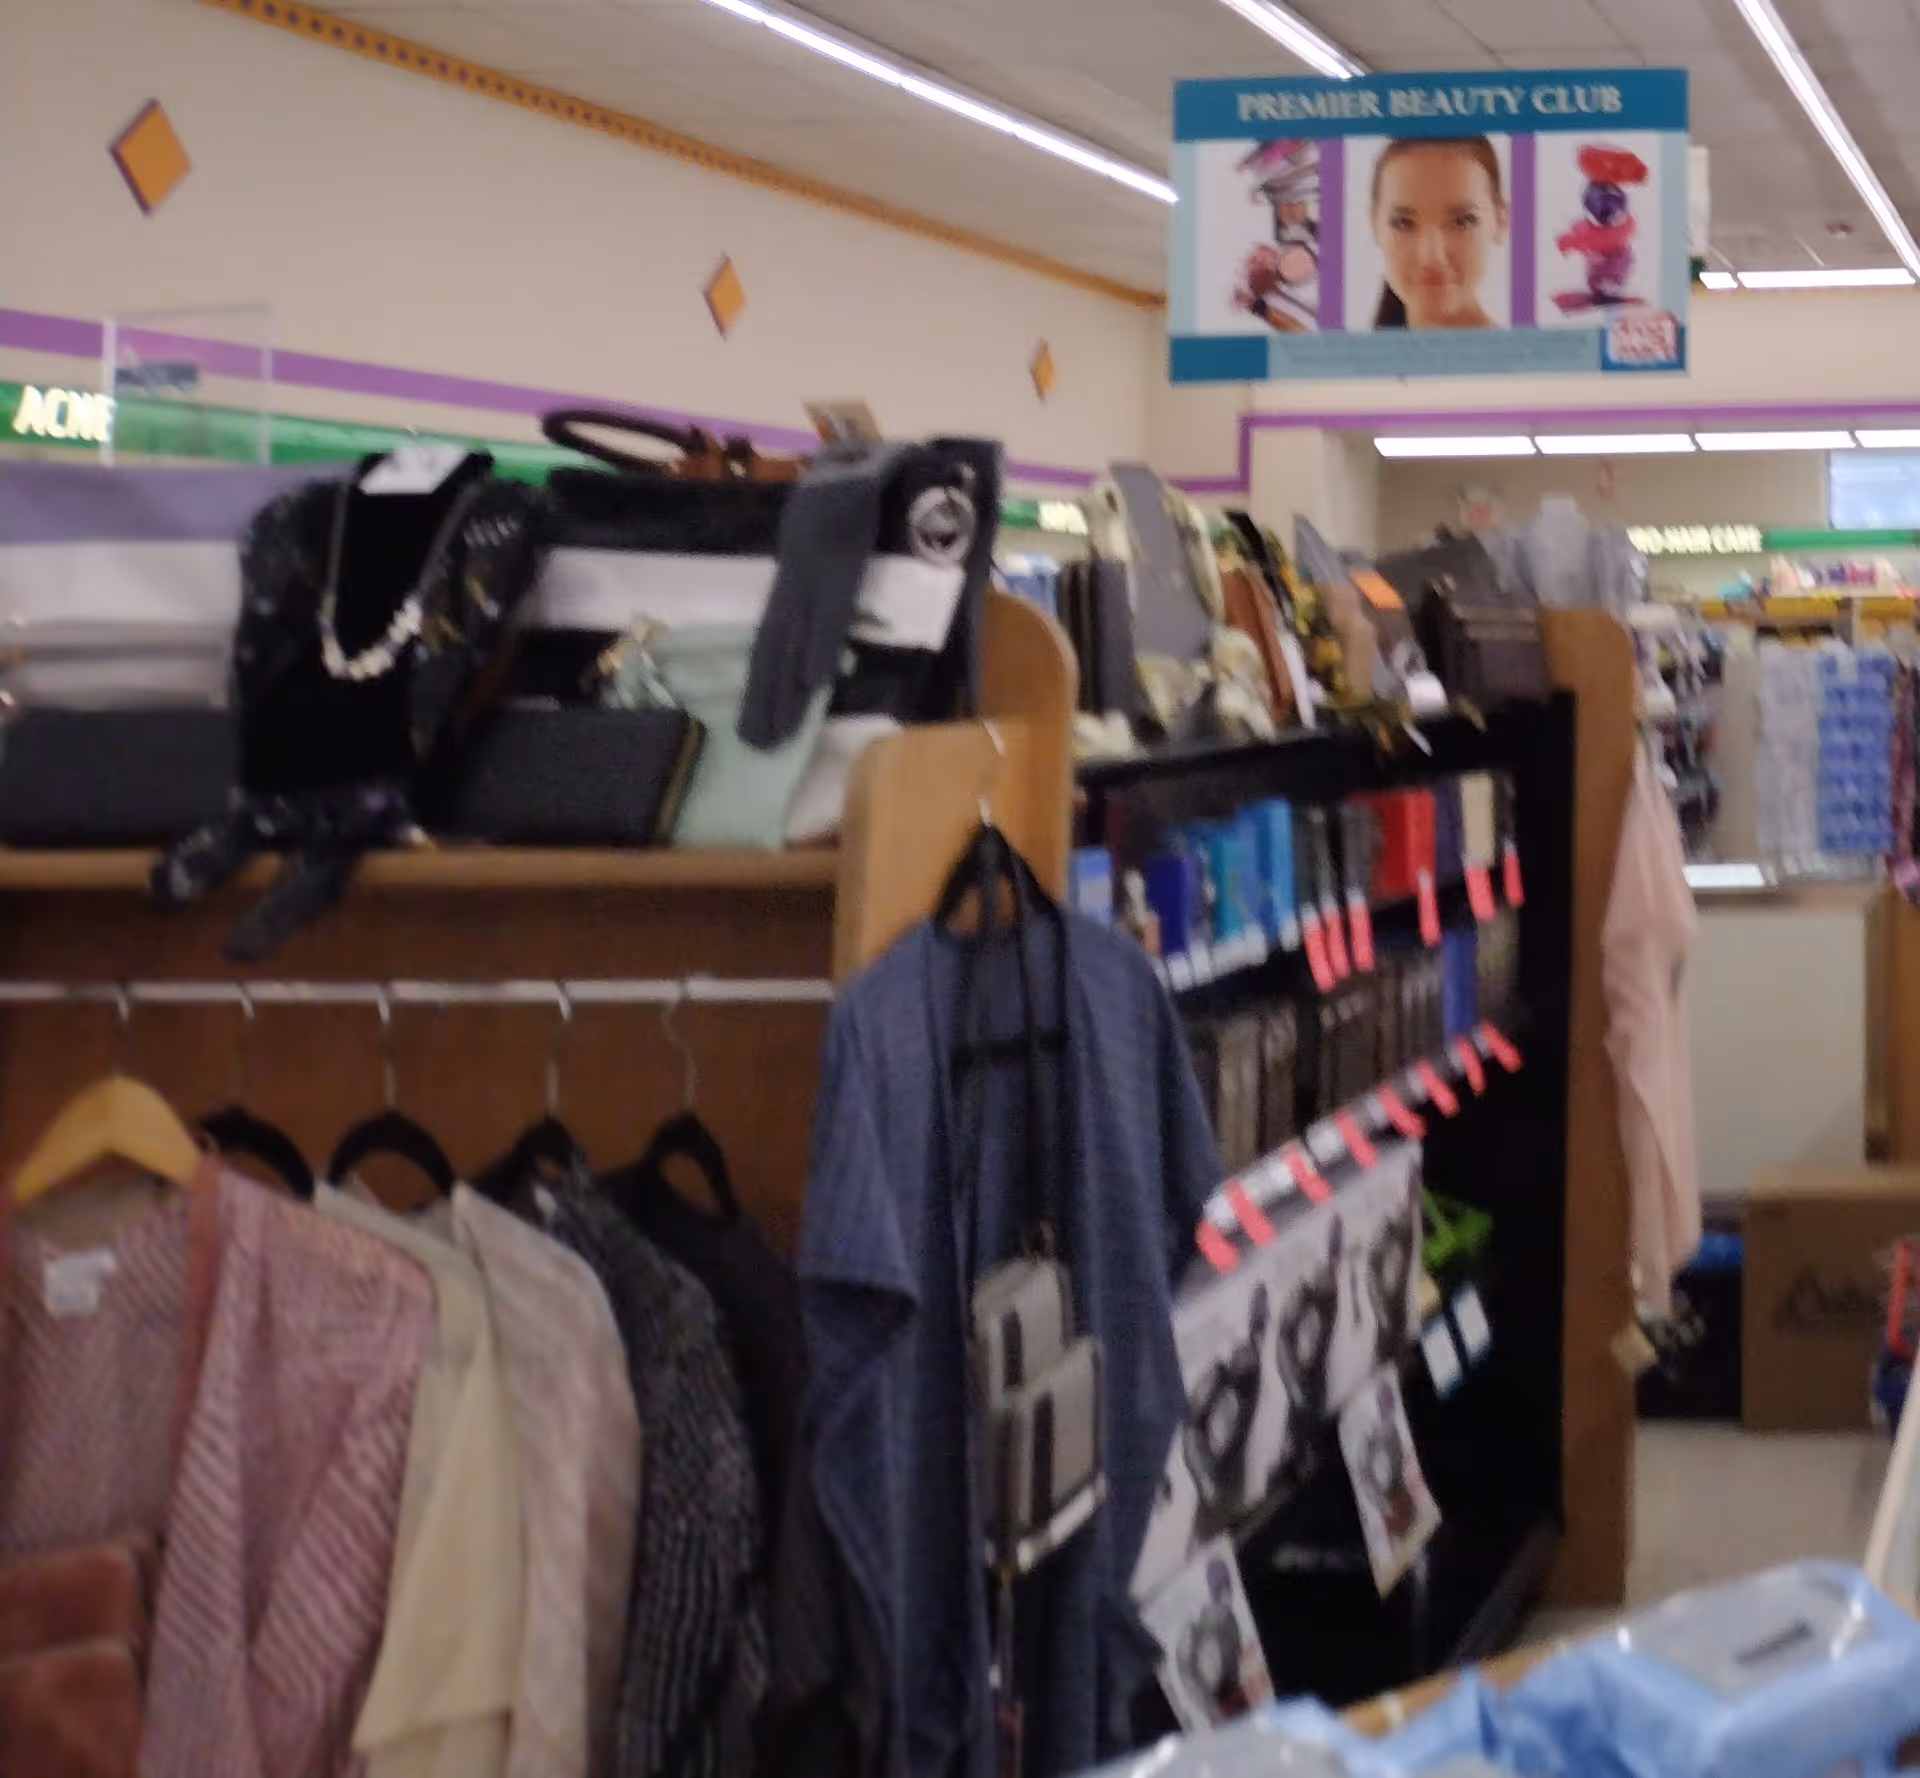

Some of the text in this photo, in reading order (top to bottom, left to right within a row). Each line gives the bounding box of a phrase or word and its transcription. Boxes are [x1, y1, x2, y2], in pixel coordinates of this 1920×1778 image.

[1237, 83, 1623, 122] PREMIER BEAUTY CLUB
[11, 384, 116, 442] ACNE
